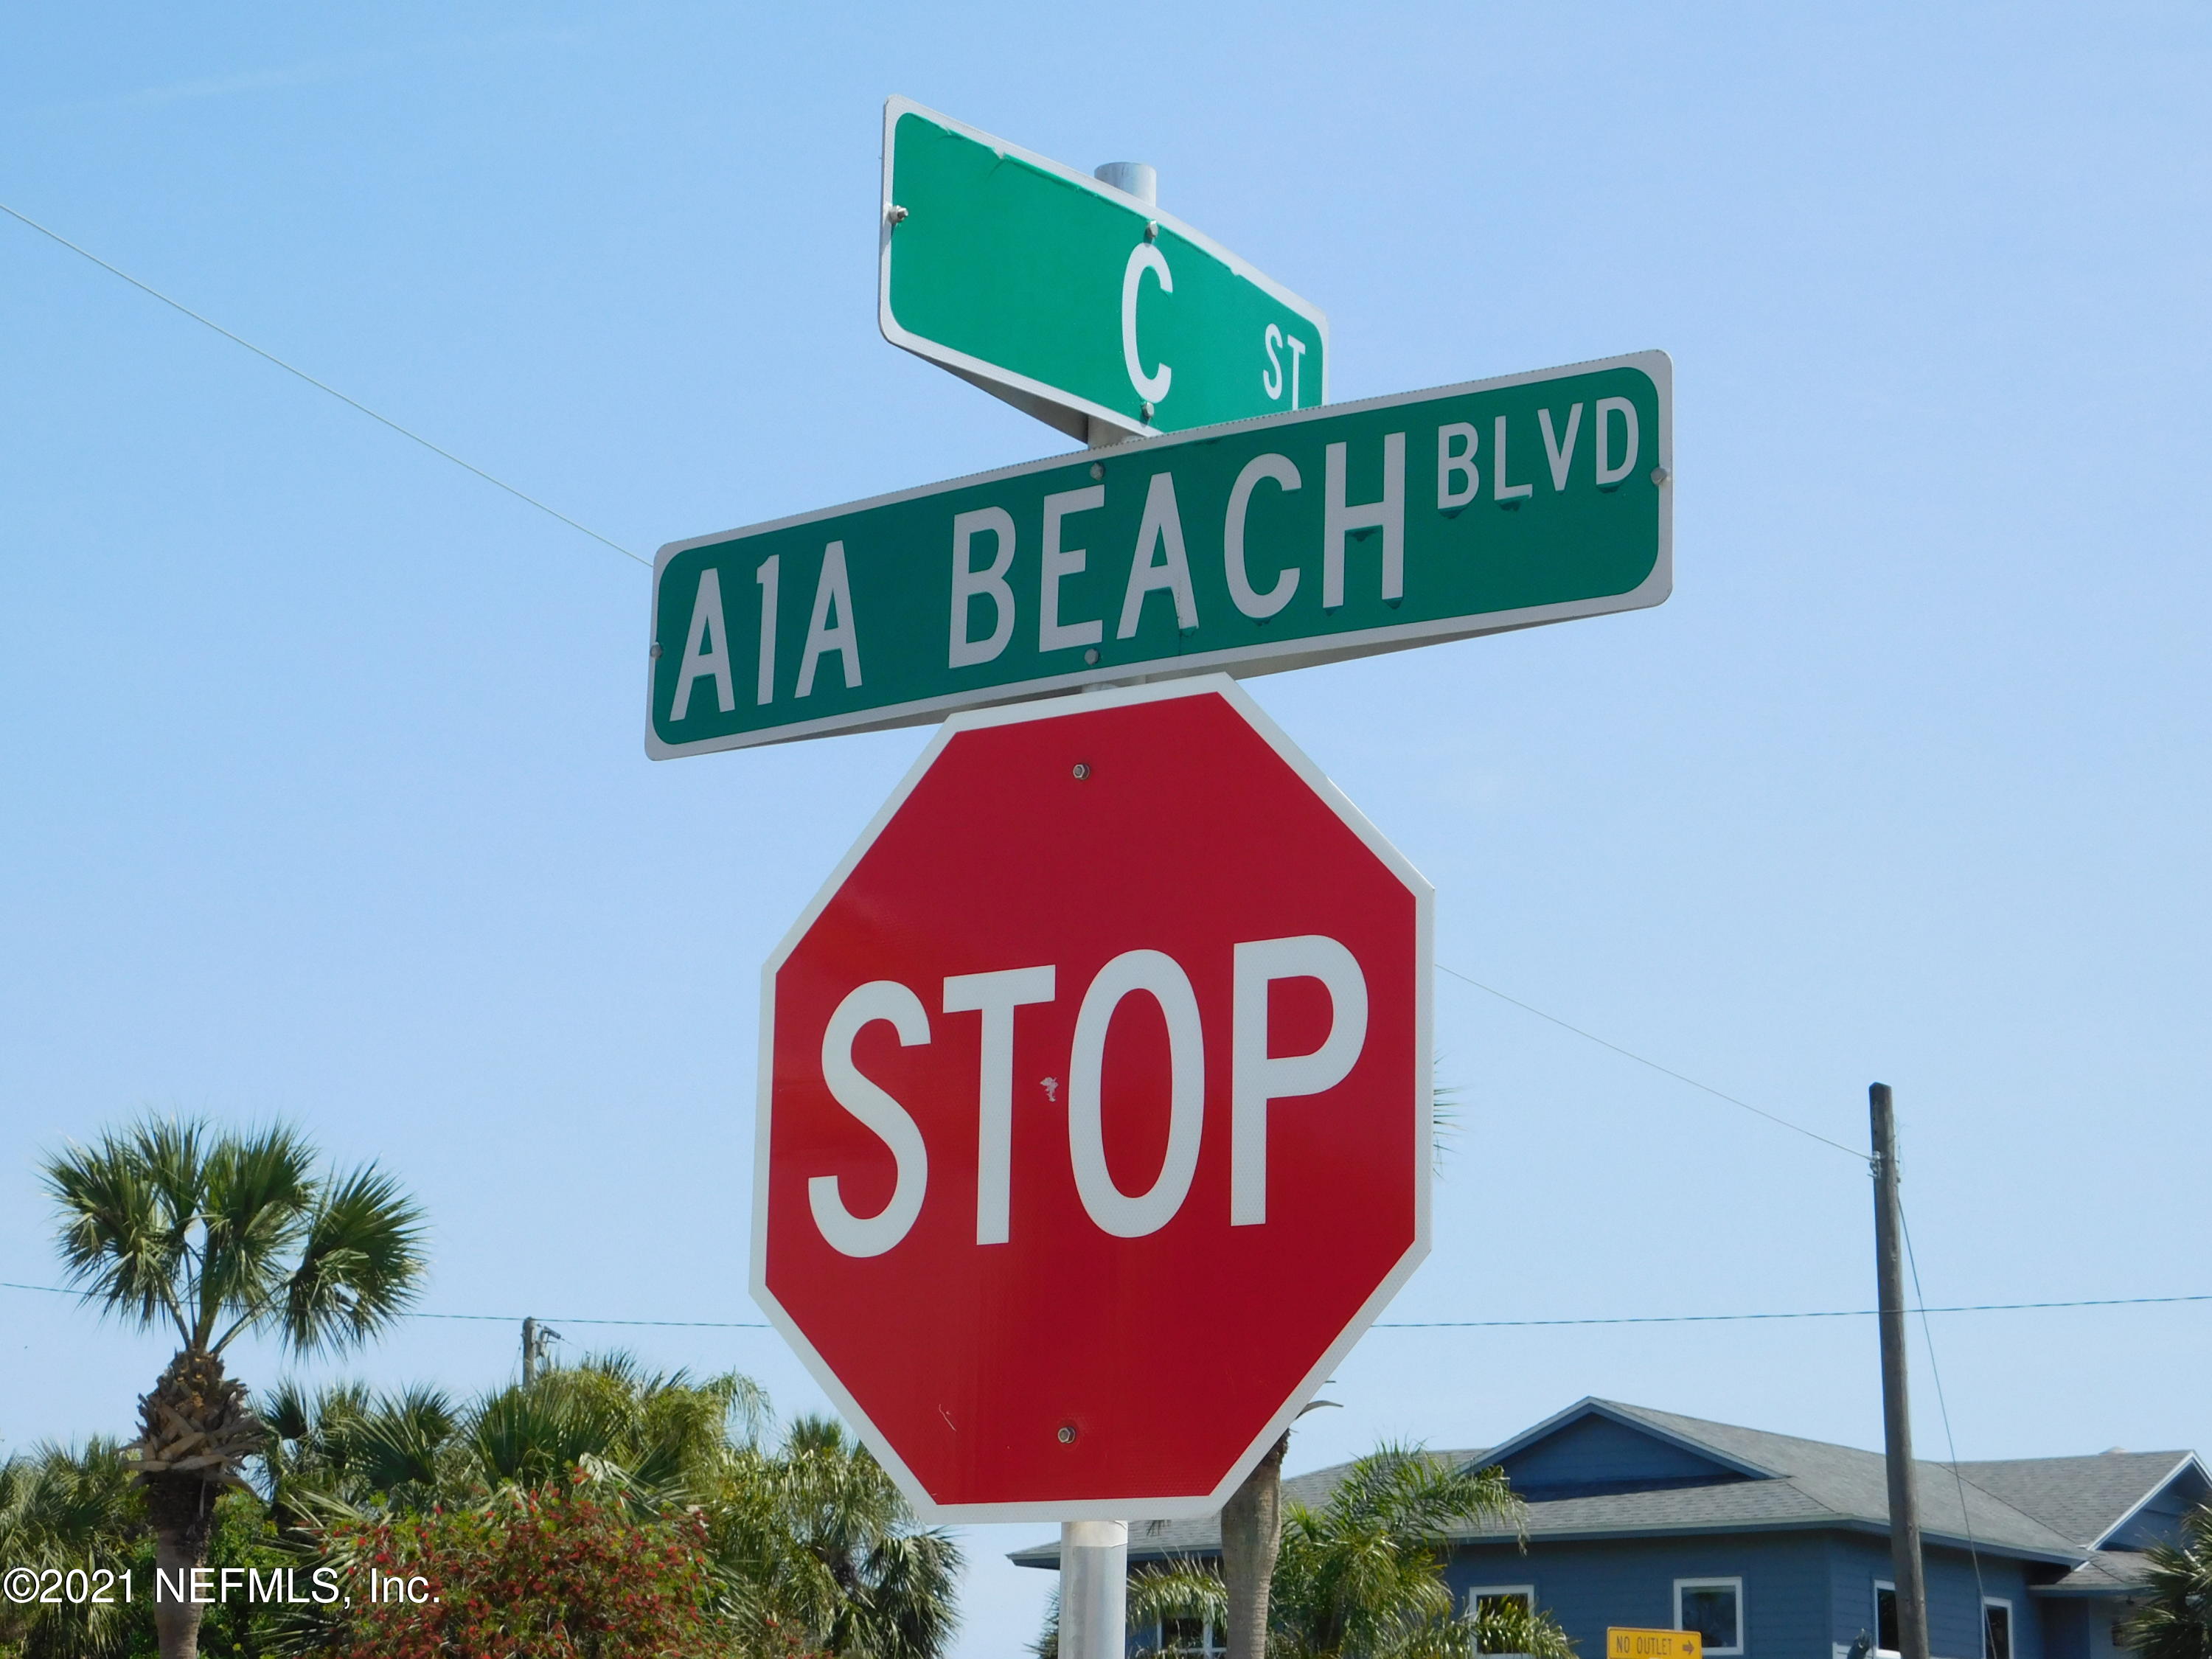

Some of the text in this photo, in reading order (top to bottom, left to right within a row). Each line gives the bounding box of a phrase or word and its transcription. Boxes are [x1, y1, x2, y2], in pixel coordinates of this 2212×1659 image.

[1122, 242, 1305, 410] C ST
[669, 396, 1639, 721] A1A BEACH BLVD
[808, 934, 1368, 1258] STOP
[1616, 1635, 1672, 1655] NO OUTLET
